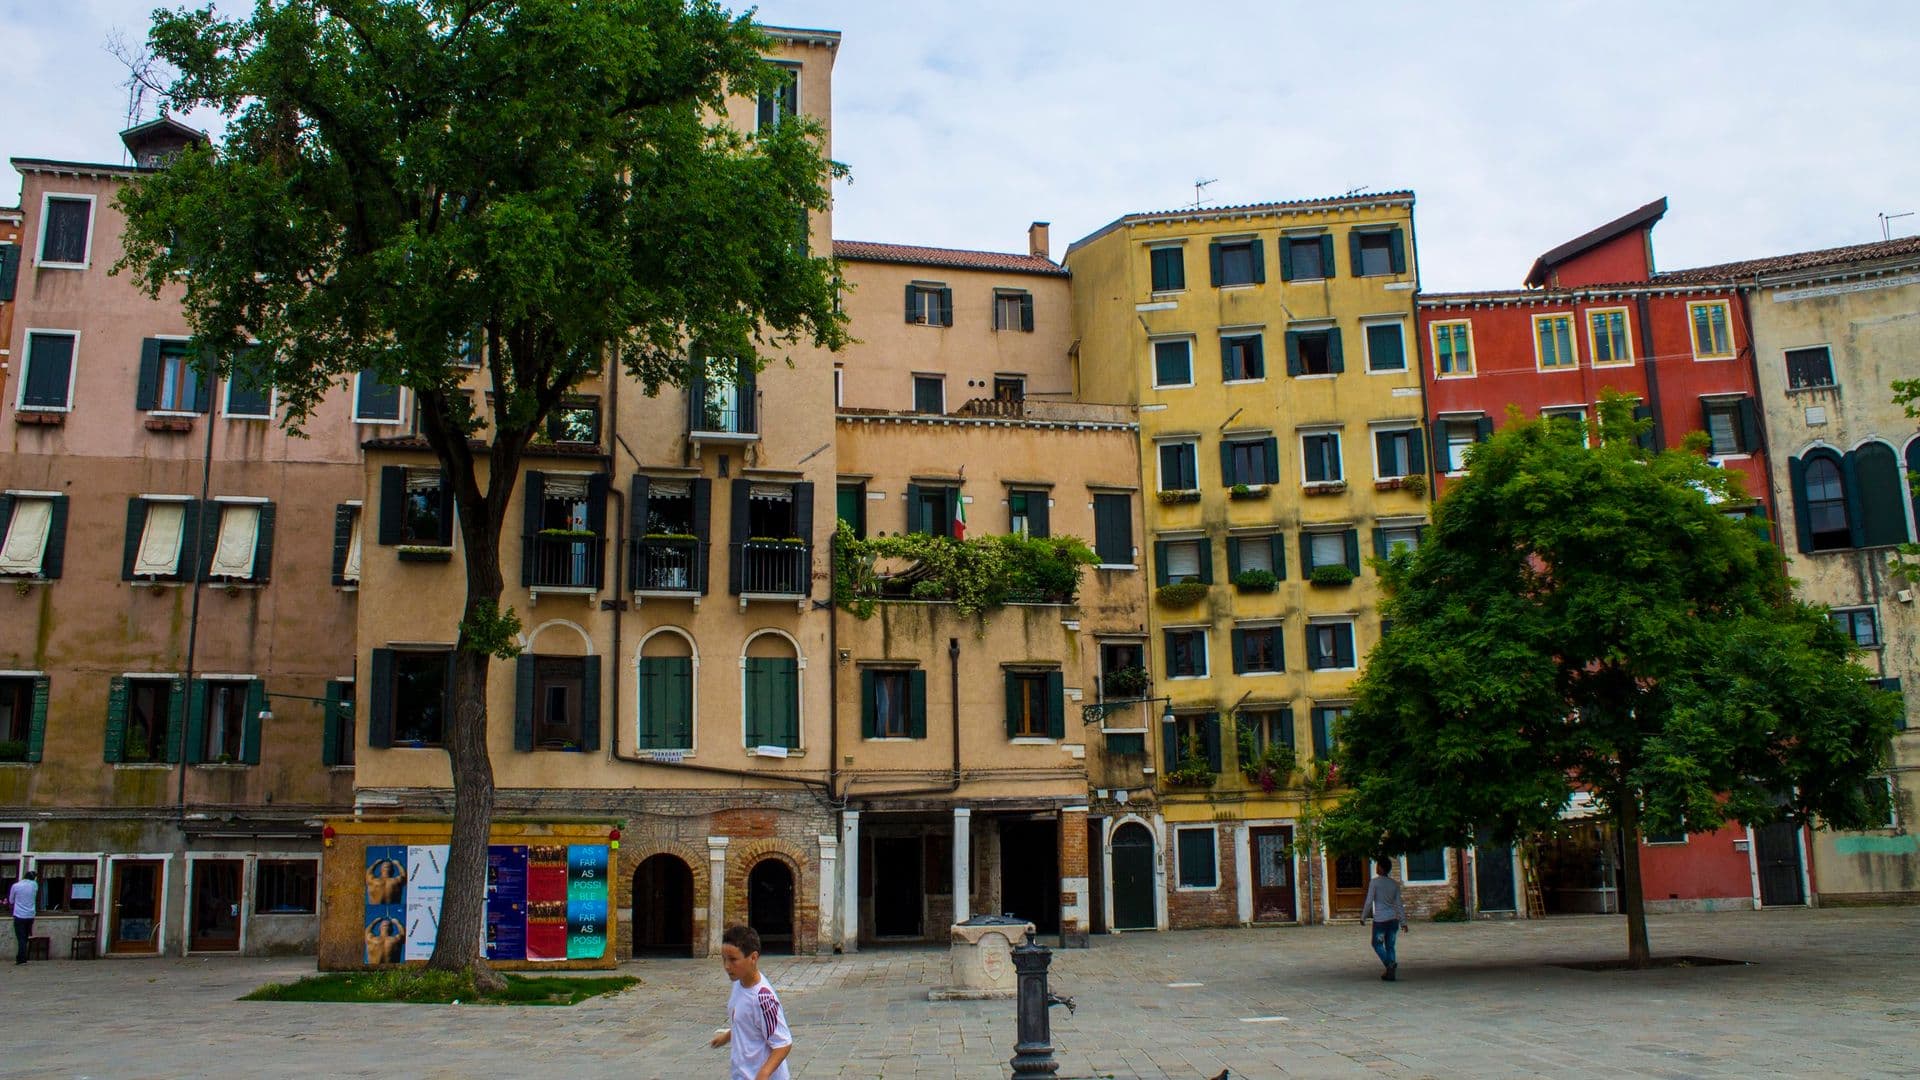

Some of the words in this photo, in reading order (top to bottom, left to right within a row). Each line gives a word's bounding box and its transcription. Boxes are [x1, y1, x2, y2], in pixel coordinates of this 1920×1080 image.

[582, 847, 594, 855] AS
[581, 870, 594, 878] AS
[574, 881, 601, 889] POSSI
[580, 892, 597, 901] BLE
[582, 902, 593, 911] AS
[579, 913, 596, 921] FAR
[580, 925, 593, 933] AS
[573, 936, 600, 944] POSSI
